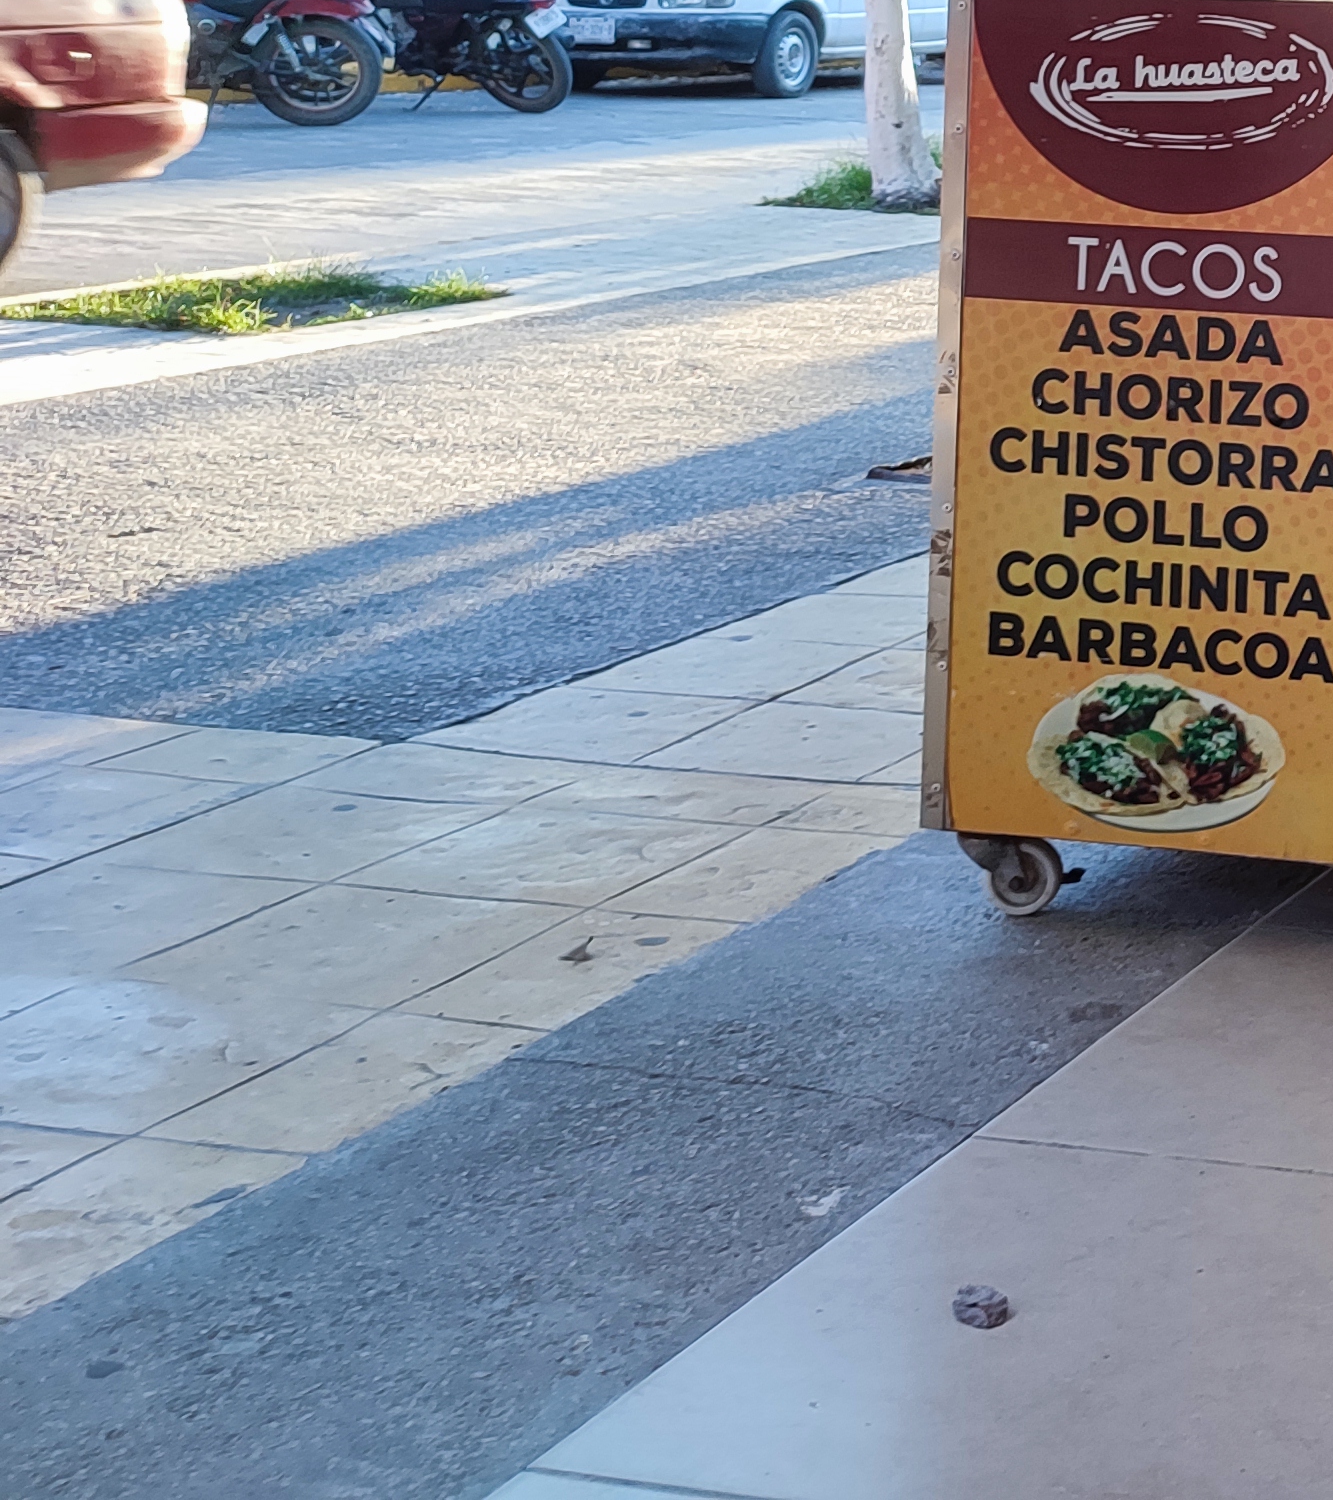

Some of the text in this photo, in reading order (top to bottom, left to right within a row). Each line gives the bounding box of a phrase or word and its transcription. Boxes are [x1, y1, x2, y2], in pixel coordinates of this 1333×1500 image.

[1069, 53, 1300, 91] La huasteca
[1067, 236, 1283, 302] TACOS
[1058, 309, 1284, 367] ASADA
[1030, 367, 1310, 430] CHORIZO
[1063, 493, 1270, 552] POLLO
[996, 550, 1332, 621] COCHINITA
